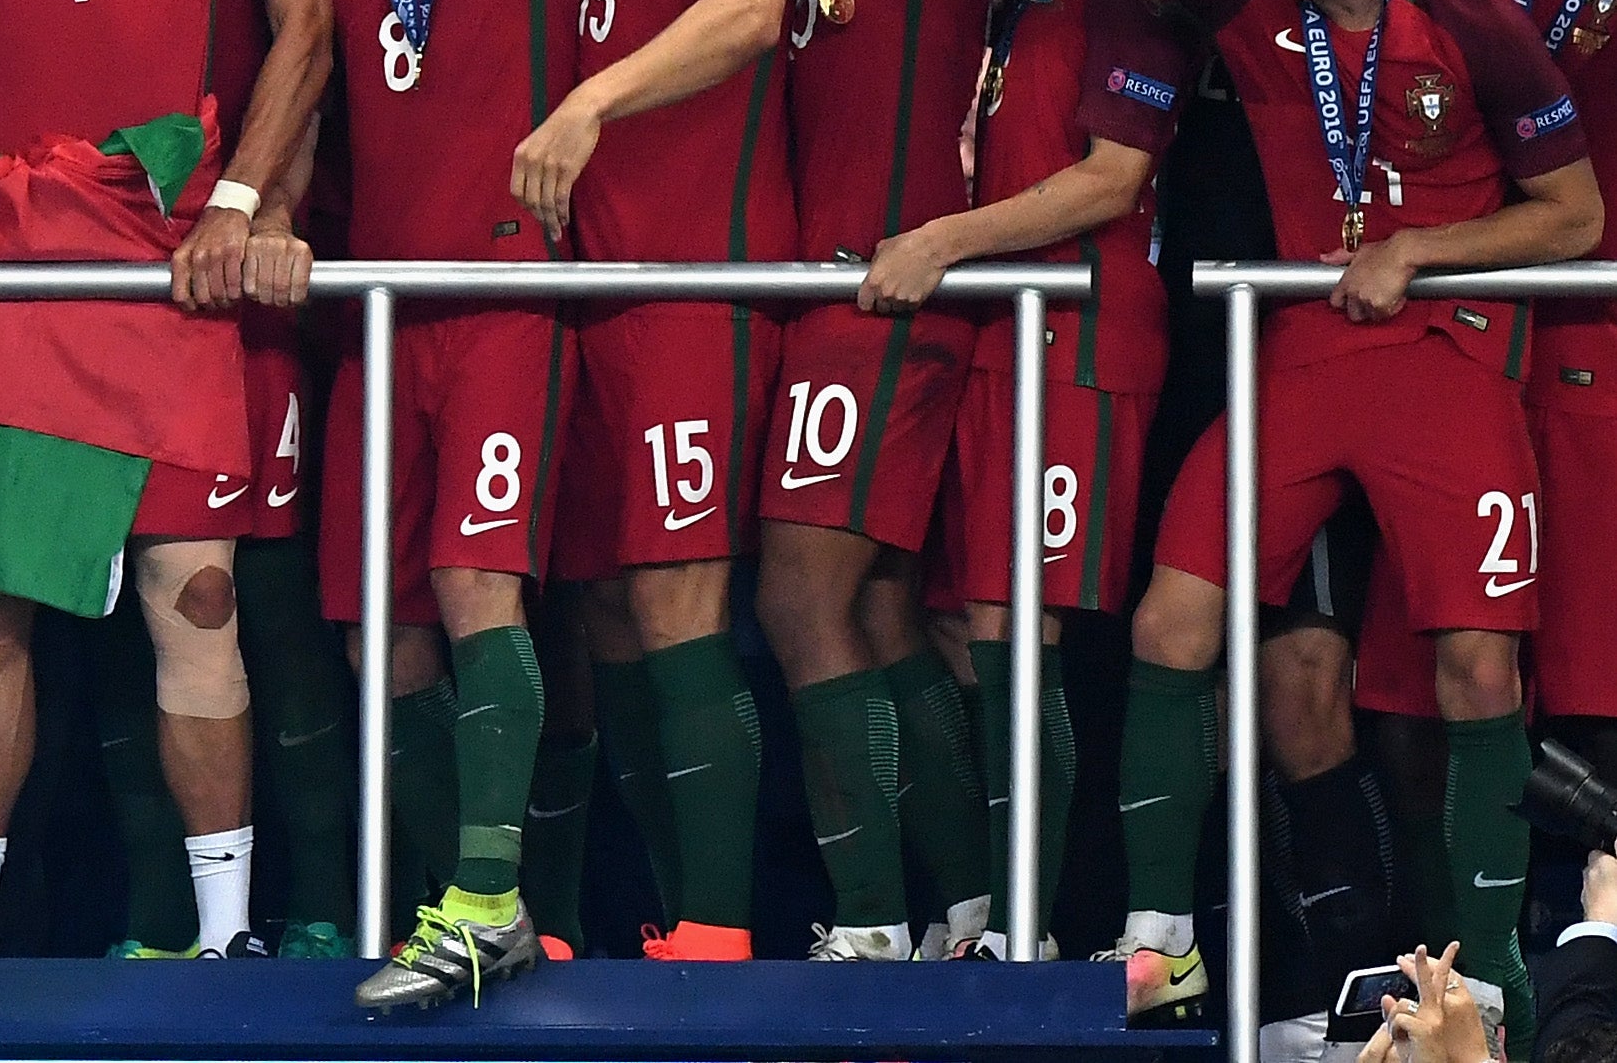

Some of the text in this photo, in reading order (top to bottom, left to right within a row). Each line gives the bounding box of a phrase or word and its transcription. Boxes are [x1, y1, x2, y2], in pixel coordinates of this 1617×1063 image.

[378, 11, 418, 92] 8
[1308, 28, 1334, 87] EURO
[1546, 14, 1572, 51] 201
[1125, 78, 1174, 105] RESPECT
[1318, 90, 1344, 144] 2016
[1357, 66, 1375, 125] UEFA
[645, 420, 714, 507] 15
[786, 381, 858, 467] 10
[476, 432, 522, 512] 8
[1044, 464, 1078, 549] 8
[1478, 491, 1538, 574] 21
